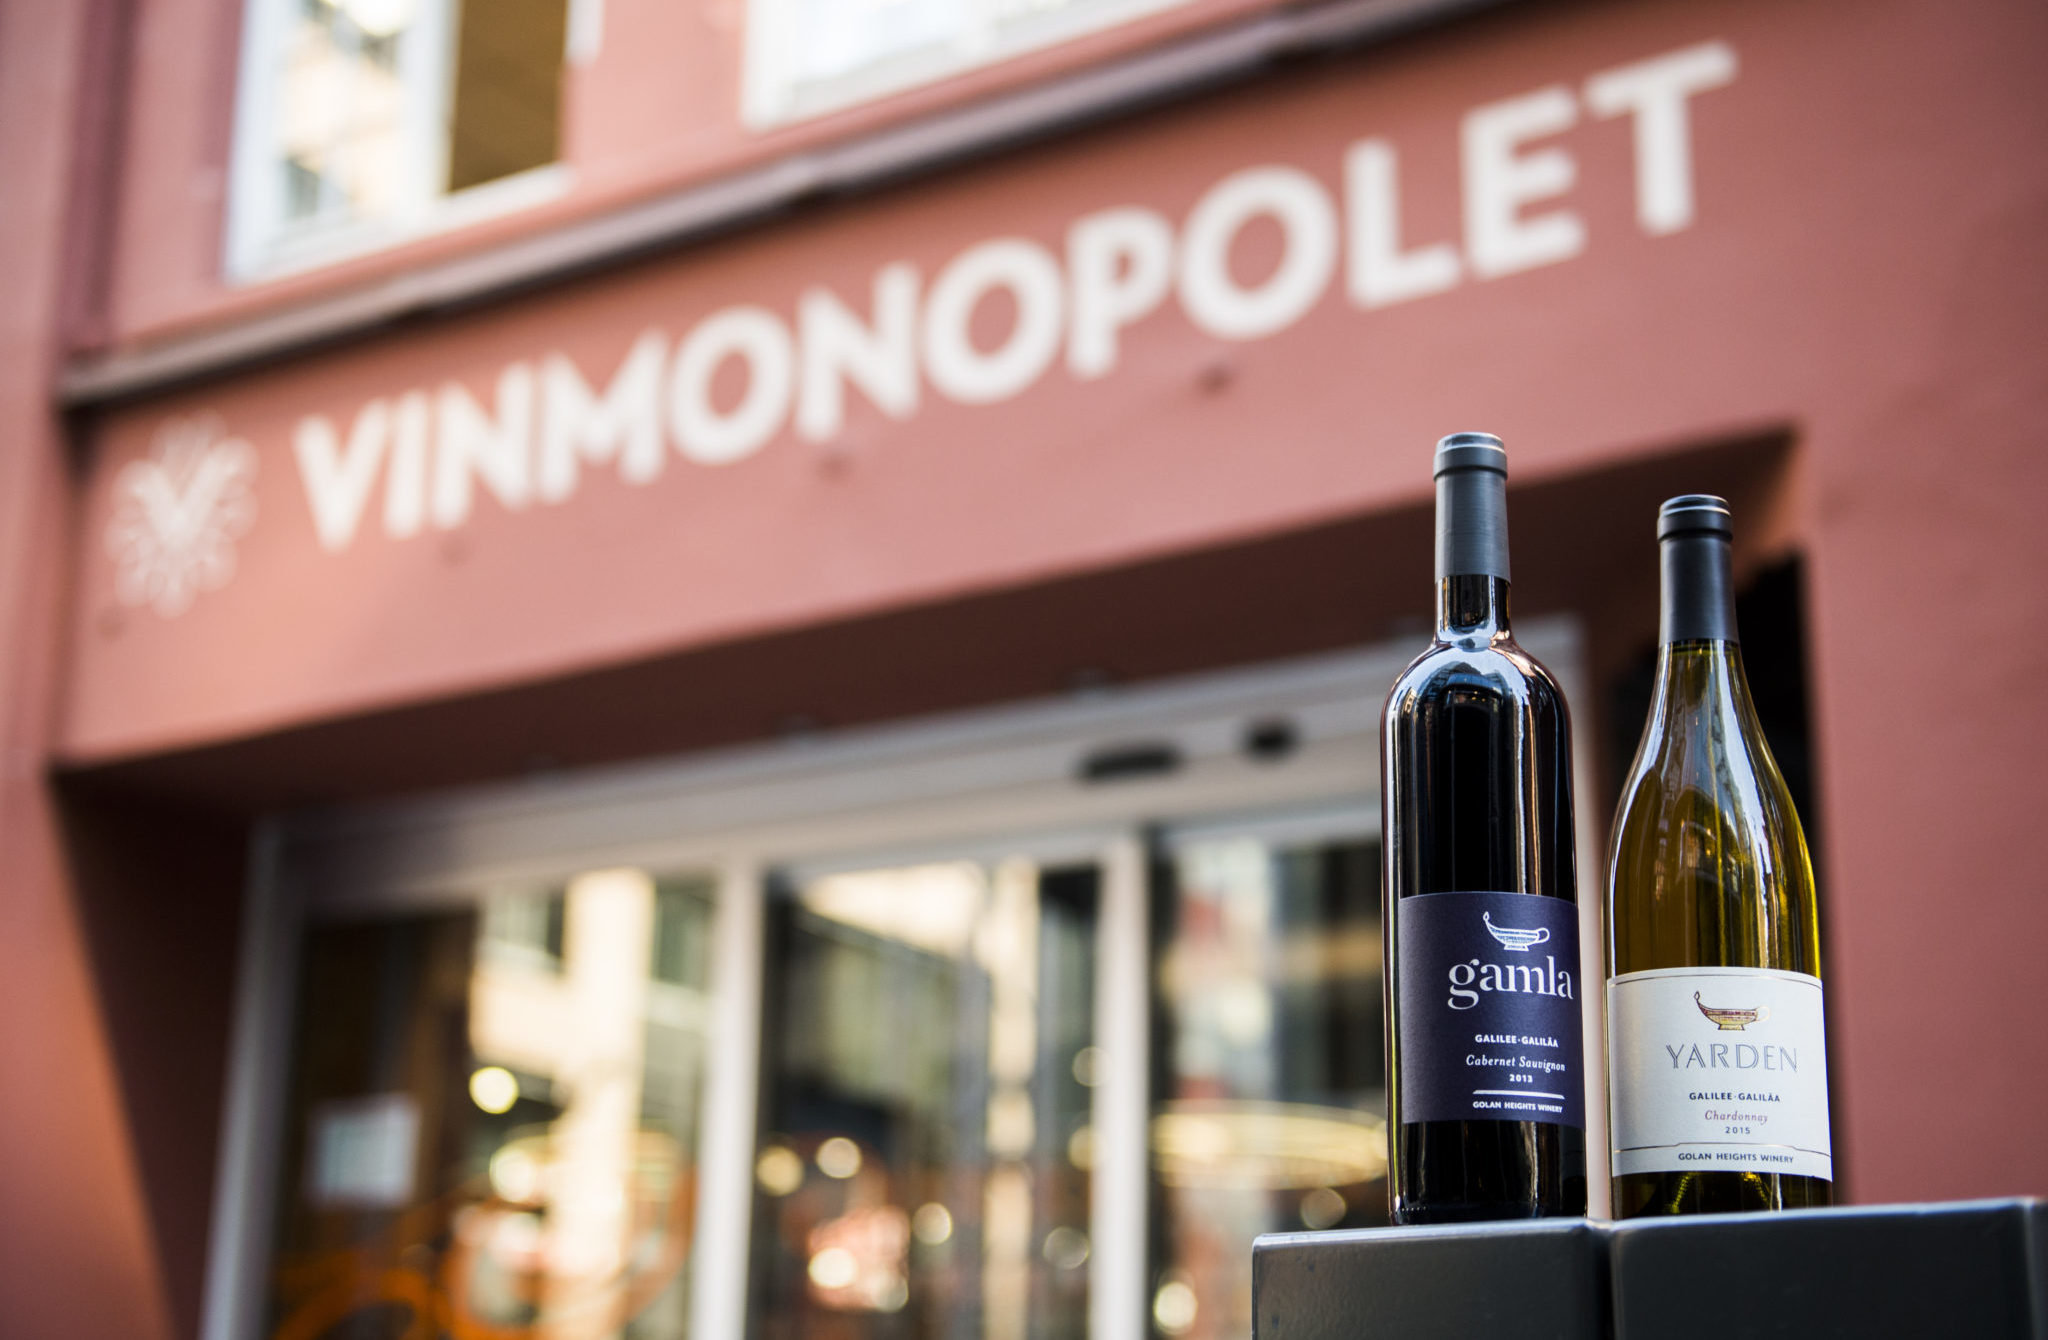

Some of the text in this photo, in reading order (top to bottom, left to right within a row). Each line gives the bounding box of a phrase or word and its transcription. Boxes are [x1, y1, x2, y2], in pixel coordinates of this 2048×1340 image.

[295, 42, 1738, 550] VINMONOPOLET
[1448, 955, 1573, 1010] gamla
[1466, 1054, 1566, 1073] Cabernet Sauvignon
[1666, 1043, 1798, 1072] YARDEN
[1509, 1073, 1533, 1083] 2013
[1472, 1101, 1563, 1113] GOLAN HEIGHTS WINERY
[1704, 1109, 1768, 1125] Chardonnay
[1725, 1126, 1751, 1134] 2015
[1678, 1152, 1794, 1164] GOLAN HEIGHTS WINERY
